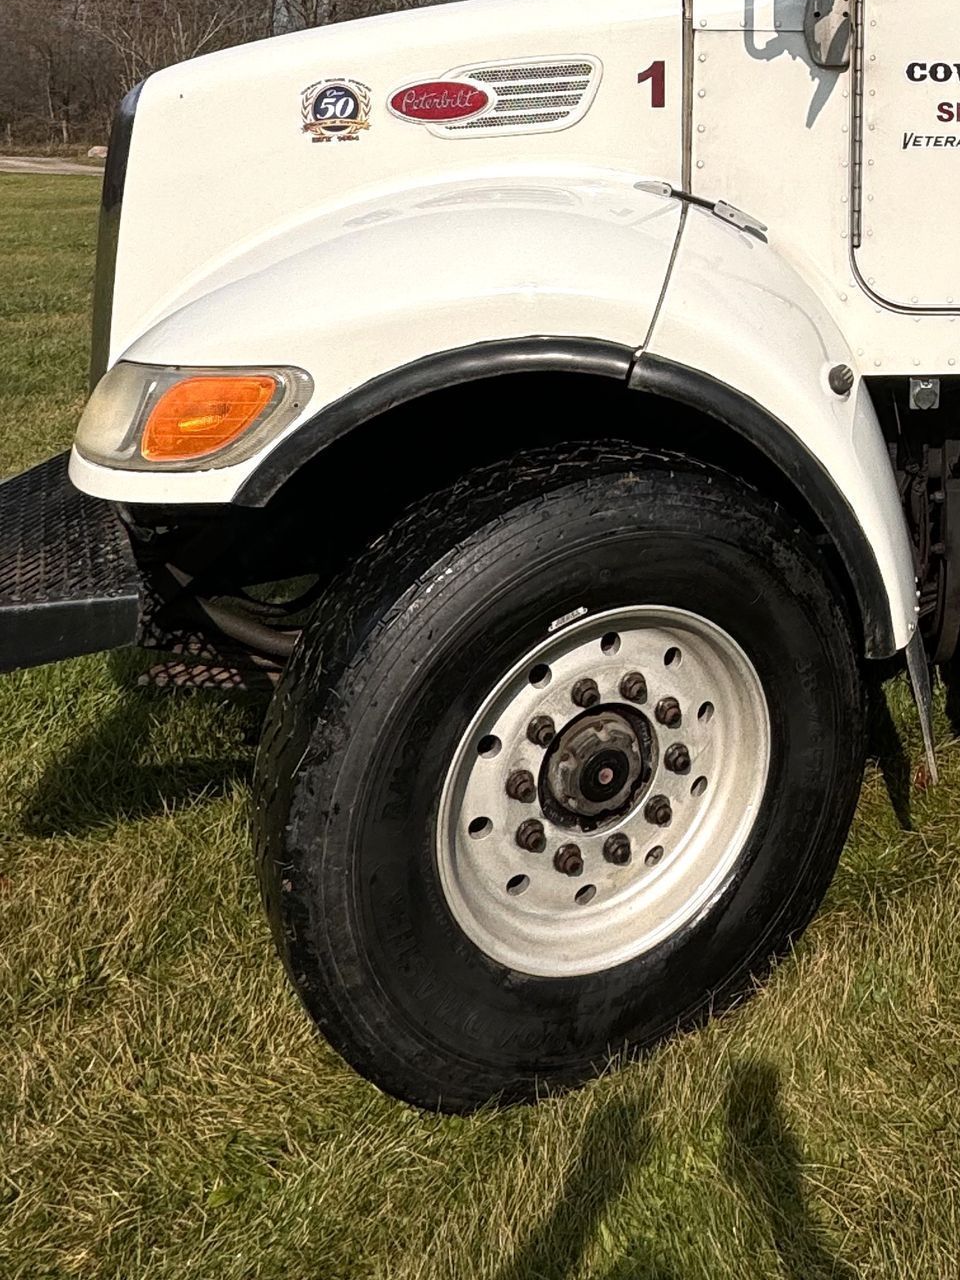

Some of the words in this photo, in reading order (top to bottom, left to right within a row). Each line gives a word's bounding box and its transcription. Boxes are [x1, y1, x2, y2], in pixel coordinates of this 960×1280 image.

[637, 60, 665, 108] 1
[316, 97, 355, 119] 50
[402, 90, 479, 112] Peterbilt
